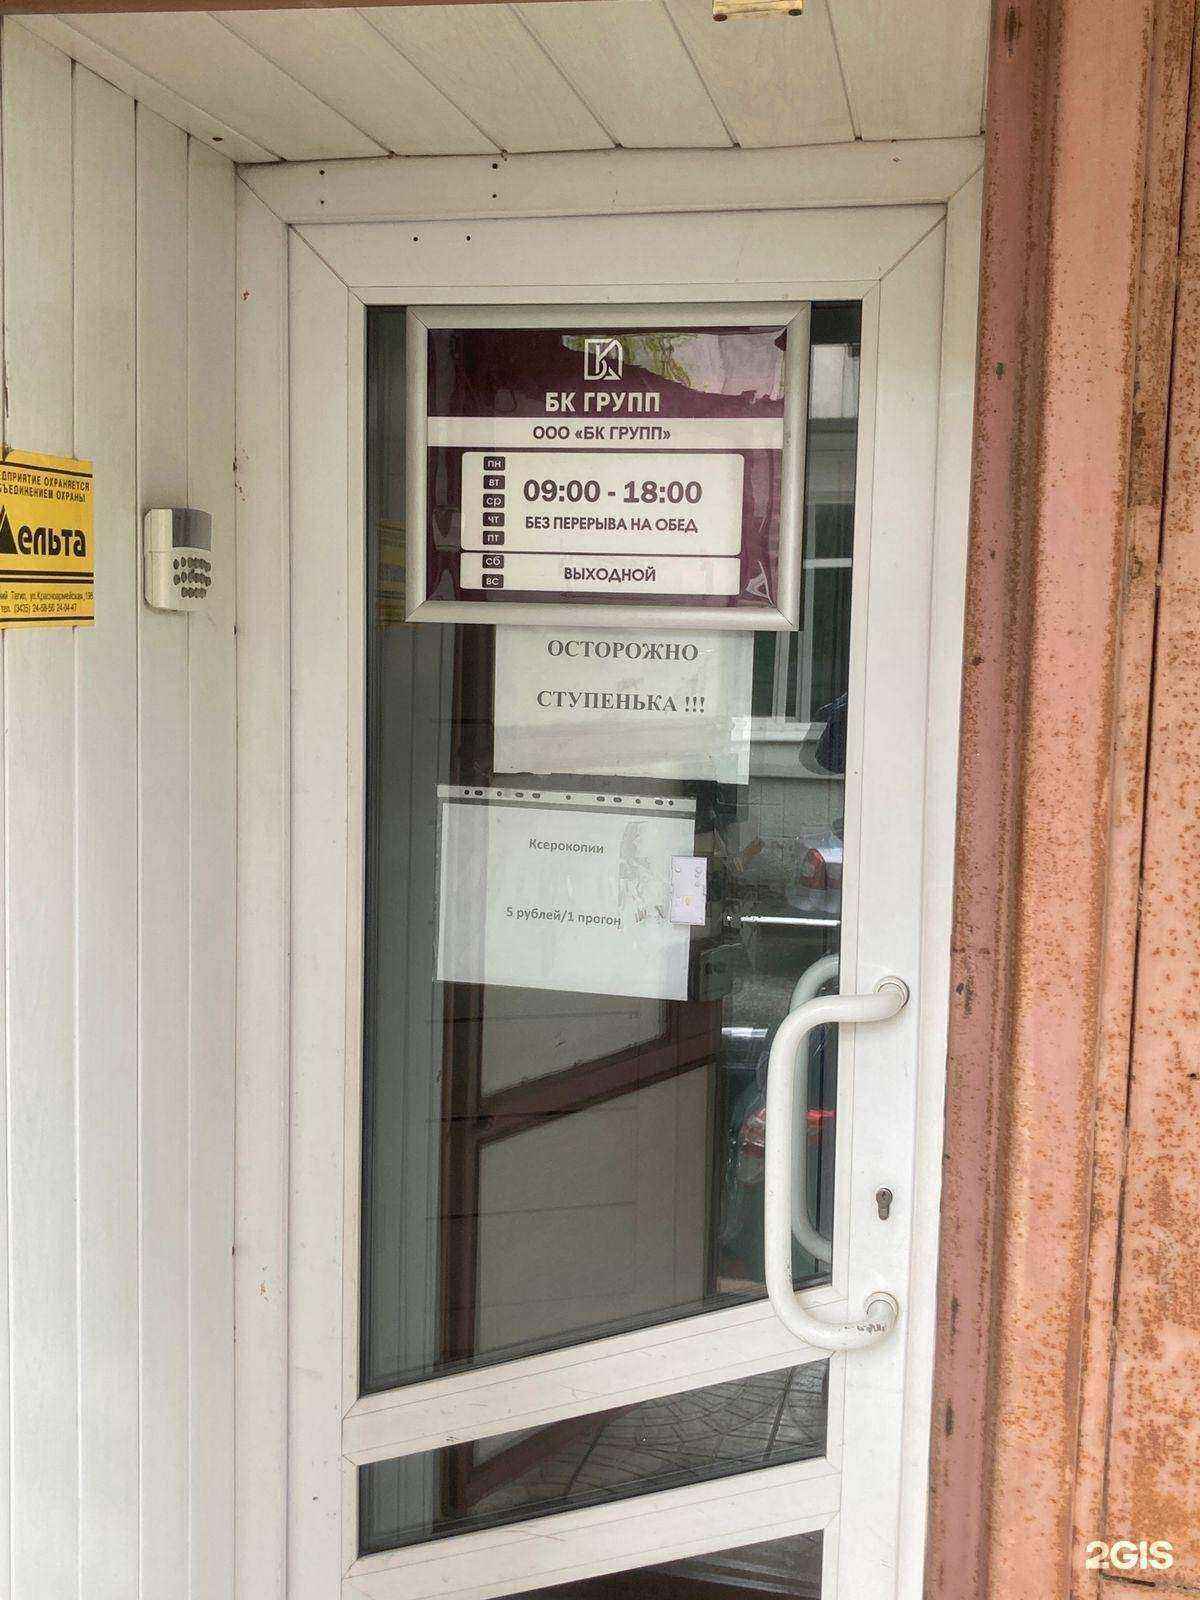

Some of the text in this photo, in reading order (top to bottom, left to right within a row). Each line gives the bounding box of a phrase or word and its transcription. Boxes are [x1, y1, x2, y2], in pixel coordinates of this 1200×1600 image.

[545, 391, 661, 413] БК ГРУПП
[533, 426, 672, 440] ООО «БК ГРУПП»
[0, 470, 41, 486] ДПРИЯТИЕ
[56, 490, 86, 502] ОХРАНЫ
[523, 479, 601, 502] 09:00
[623, 480, 703, 503] 18:00
[525, 516, 698, 533] БЕЗ ПЕРЕРЫВА НА ОБЕД
[564, 566, 656, 582] ВЫХОДНОЙ
[546, 639, 699, 661] ОСТОРОЖНО
[536, 690, 678, 712] СТУПЕНЬКА
[528, 838, 605, 855] Ксерокопии
[506, 907, 622, 927] 5 рублей/1 прогон
